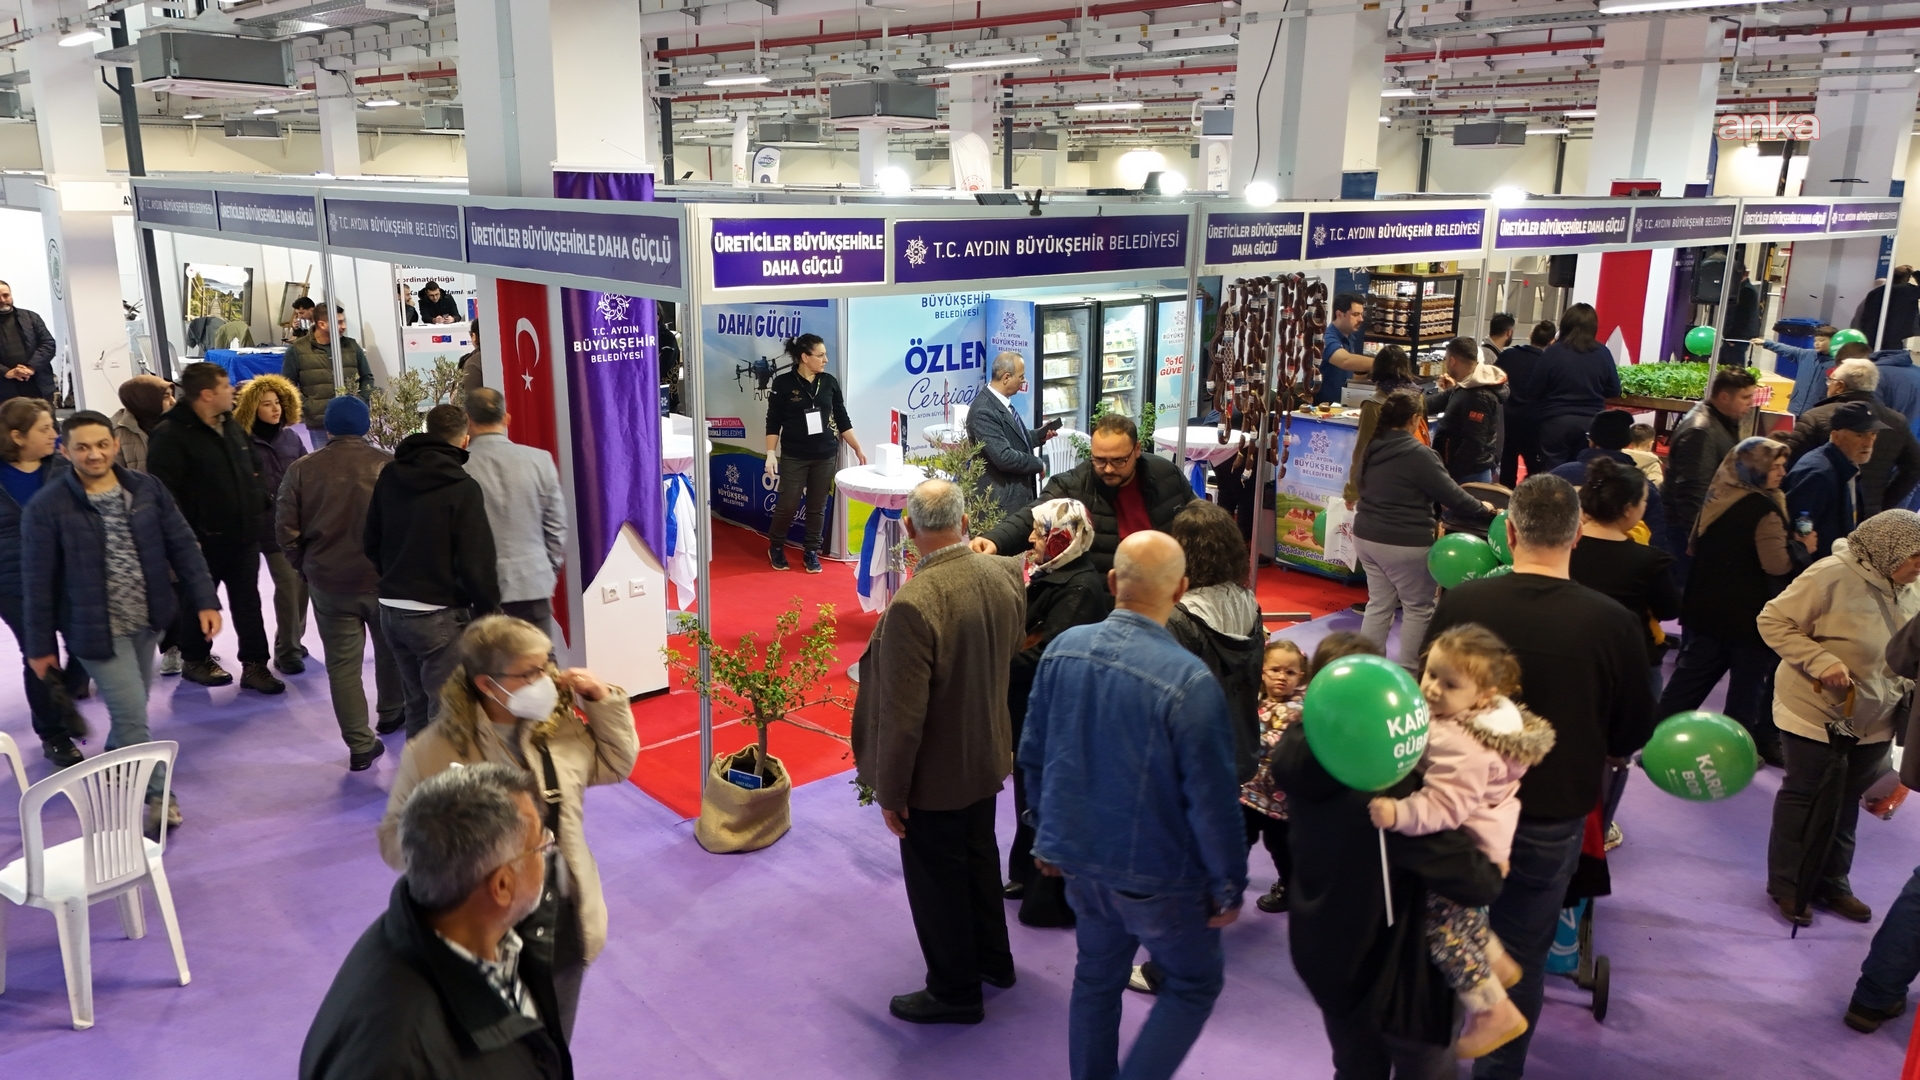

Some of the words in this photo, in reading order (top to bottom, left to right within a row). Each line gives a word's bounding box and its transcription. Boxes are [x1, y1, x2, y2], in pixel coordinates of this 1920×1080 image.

[220, 202, 245, 220] ÜRETİCİLER
[245, 205, 280, 224] BÜYÜKŞEHİRLE
[280, 210, 296, 225] DAHA
[296, 208, 314, 228] GÜÇLÜ
[1654, 219, 1671, 229] AYDIN
[1672, 215, 1705, 230] BÜYÜKŞEHİR
[1705, 214, 1732, 227] BELEDİYESİ
[339, 216, 350, 230] T.C.
[351, 218, 369, 231] AYDIN
[370, 216, 414, 237] BÜYÜKŞEHİR
[415, 221, 459, 240] BELEDİYESİ
[1208, 224, 1249, 239] ÜRETİCİLER
[1250, 221, 1303, 237] BÜYÜKŞEHİRLE
[1329, 228, 1346, 241] T.C.
[1347, 226, 1375, 239] AYDIN
[1378, 222, 1433, 241] BÜYÜKŞEHİR
[1434, 221, 1481, 237] BELEDİYESİ
[1500, 218, 1539, 236] ÜRETİCİLER
[1539, 217, 1587, 237] BÜYÜKŞEHİRLE
[1587, 221, 1605, 234] DAHA
[1605, 216, 1626, 235] GÜÇLÜ
[471, 225, 521, 250] ÜRETİCİLER
[522, 227, 597, 257] BÜYÜKŞEHİRLE
[598, 235, 630, 260] DAHA
[631, 233, 672, 266] GÜÇLÜ
[714, 231, 791, 253] ÜRETİCİLER
[793, 230, 884, 254] BÜYÜKŞEHİRLE
[933, 242, 961, 259] T.C.
[964, 240, 1010, 258] AYDIN
[1016, 233, 1104, 257] BÜYÜKŞEHİR
[1109, 230, 1179, 250] BELEDİYESİ
[1232, 244, 1253, 256] DAHA
[1253, 240, 1278, 256] GÜÇLÜ
[762, 260, 800, 277] DAHA
[802, 255, 843, 278] GÜÇLÜ
[921, 291, 991, 308] BÜYÜKŞEHİR
[935, 307, 979, 319] BELEDİYESİ
[593, 327, 609, 336] T.C.
[611, 325, 639, 335] AYDIN
[717, 313, 752, 335] DAHA
[754, 309, 802, 342] GÜÇLÜ
[573, 334, 656, 352] BÜYÜKŞEHİR
[991, 337, 1029, 348] BÜYÜKŞEHİR
[591, 350, 644, 363] BELEDİYESİ
[1294, 459, 1343, 474] BÜYÜKŞEHİR
[1302, 469, 1334, 479] BELEDİYESİ
[718, 488, 749, 503] BÜYÜKŞEHİR
[1278, 543, 1305, 557] Doğadan
[1305, 549, 1324, 561] Gelen
